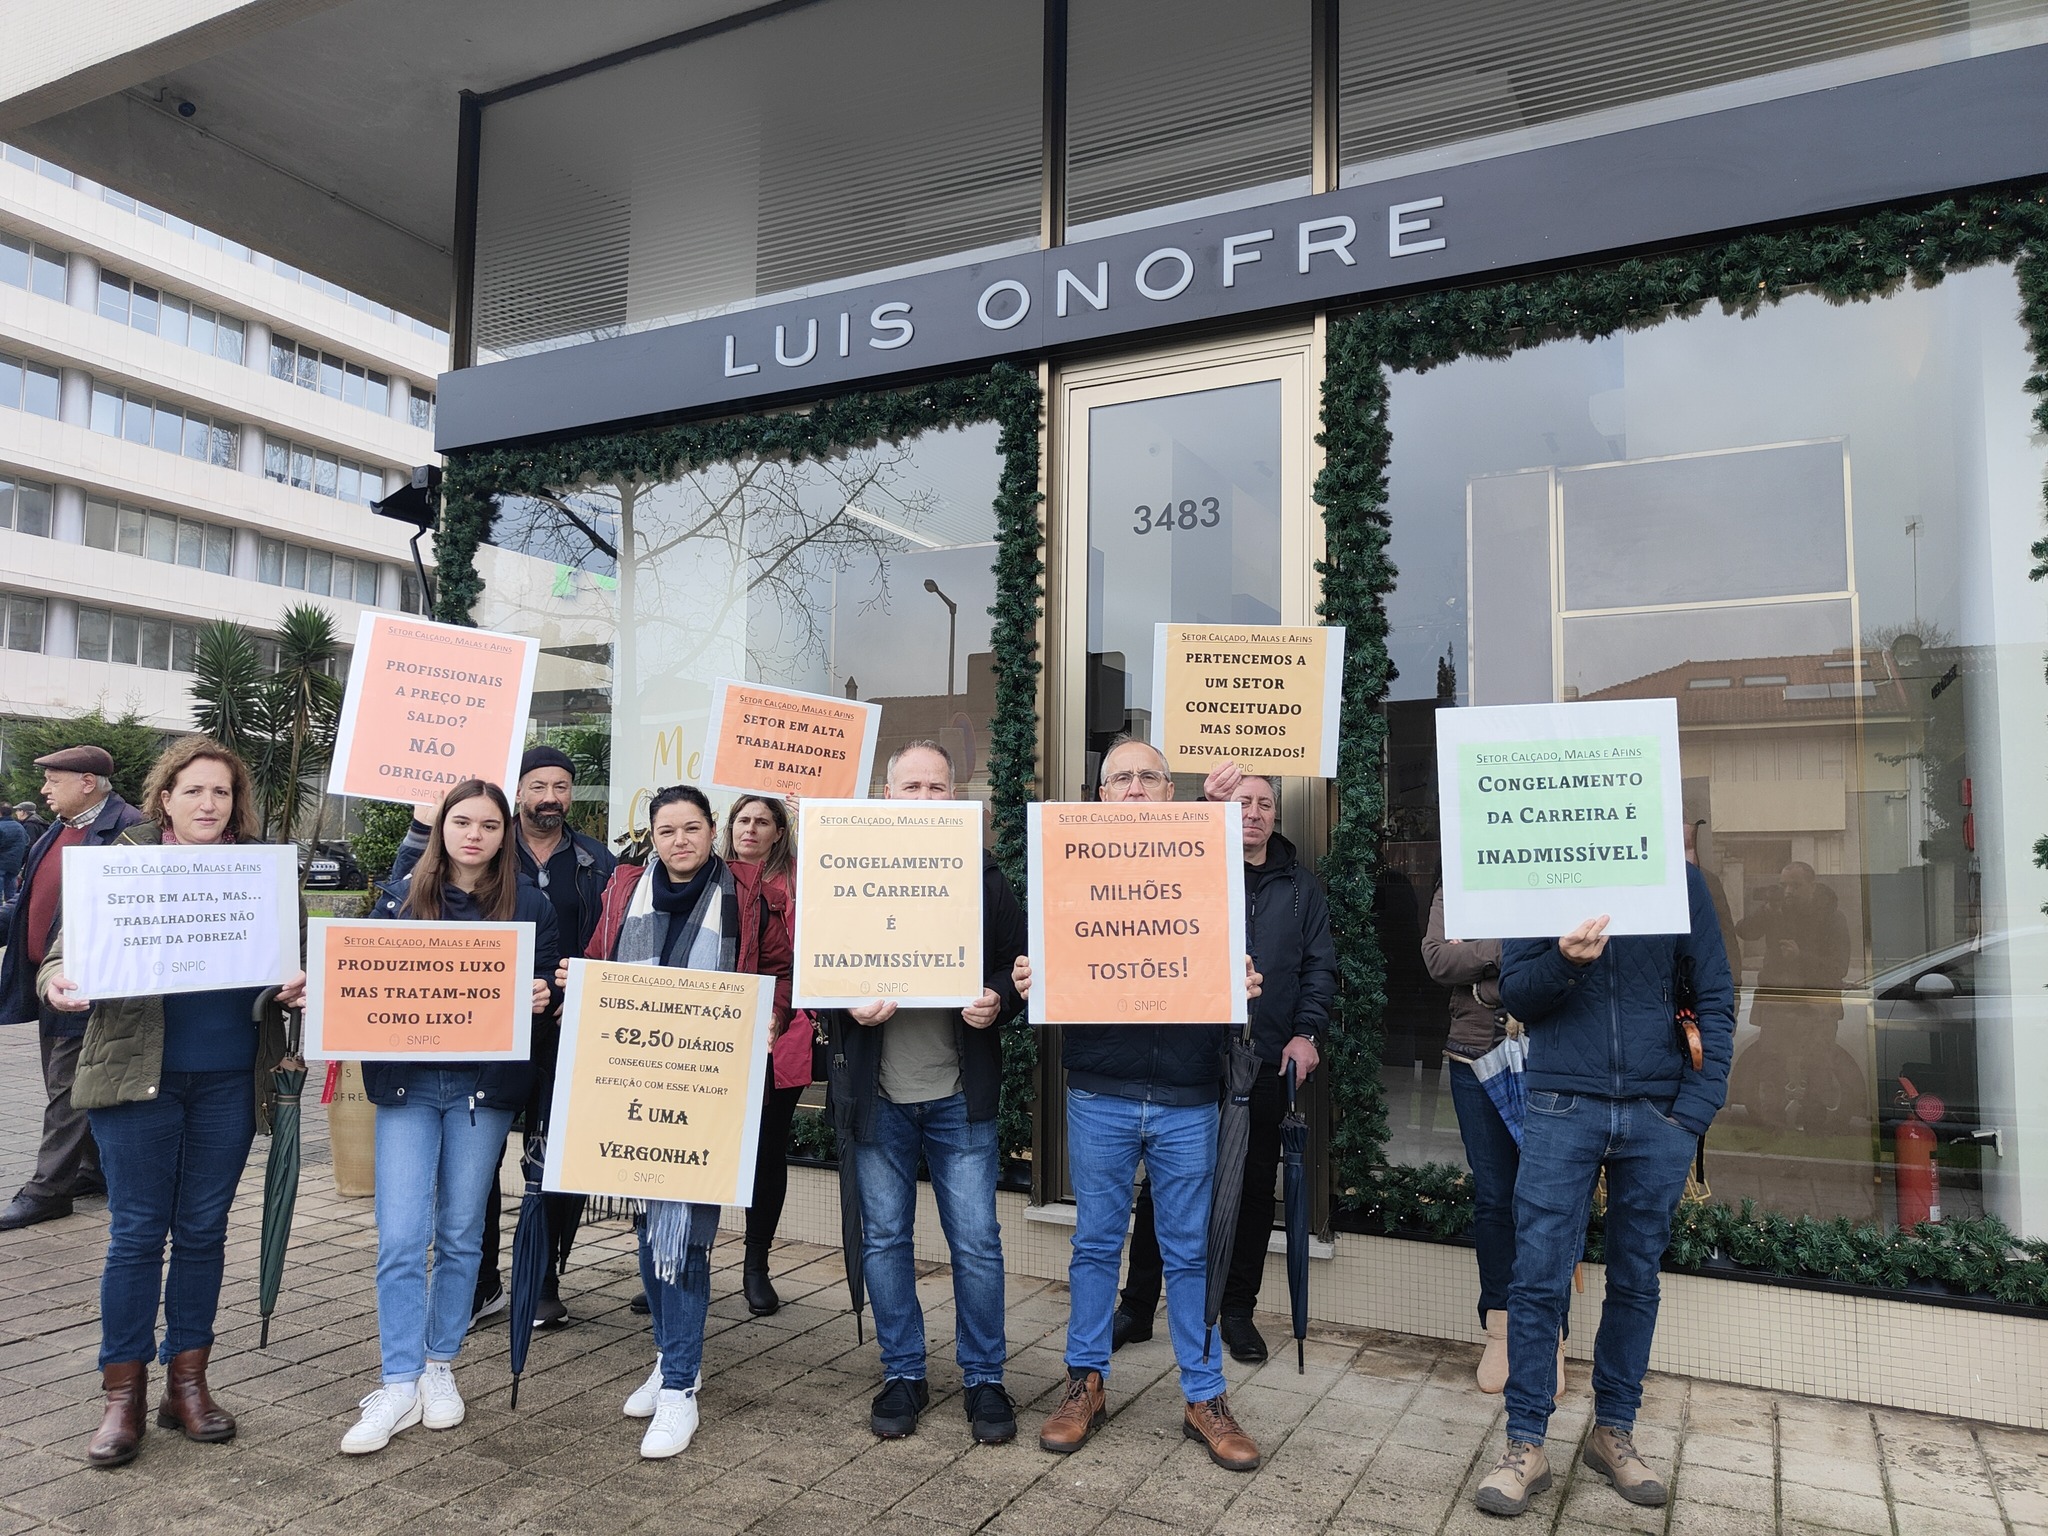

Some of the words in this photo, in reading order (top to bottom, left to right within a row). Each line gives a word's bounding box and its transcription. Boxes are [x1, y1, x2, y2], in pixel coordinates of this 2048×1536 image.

[724, 300, 915, 378] LUIS
[977, 196, 1447, 332] ONOFRE
[1133, 497, 1220, 535] 3483
[388, 626, 413, 637] SETOR
[415, 630, 453, 644] CALÇADO,
[455, 637, 483, 647] MALAS
[490, 643, 513, 653] AFINS
[1182, 633, 1207, 641] SETOR
[1209, 633, 1249, 643] CALÇADO,
[1251, 634, 1280, 643] MALAS
[1289, 635, 1312, 643] AFINS
[1186, 653, 1292, 665] PERTENCEMOS
[1296, 656, 1306, 665] A
[386, 660, 503, 687] PROFISSIONAIS
[1205, 678, 1227, 688] UM
[1233, 678, 1284, 690] SETOR
[395, 687, 405, 696] A
[411, 688, 461, 705] PREÇO
[466, 696, 486, 708] DE
[739, 695, 763, 704] SETOR
[764, 699, 799, 712] CALÇADO,
[802, 705, 827, 715] MALAS
[834, 710, 855, 719] AFINS
[1186, 701, 1302, 715] CONCEITUADO
[407, 710, 467, 728] SALDO?
[744, 714, 785, 729] SETOR
[790, 721, 809, 732] EM
[812, 725, 845, 738] ALTA
[1200, 724, 1230, 734] MAS
[1236, 725, 1286, 735] SOMOS
[409, 737, 455, 756] NÃO
[736, 735, 846, 760] TRABALHADORES
[1179, 745, 1305, 758] DESVALORIZADOS!
[1476, 753, 1508, 763] SETOR
[1511, 751, 1561, 763] CALÇADO,
[1564, 749, 1600, 760] MALAS
[1612, 748, 1642, 758] AFINS
[754, 758, 774, 770] EM
[778, 761, 822, 777] BAIXA!
[776, 779, 802, 790] SNPIC
[1478, 772, 1643, 793] CONGELAMENTO
[820, 816, 848, 825] SETOR
[851, 816, 894, 826] CALÇADO,
[897, 816, 928, 825] MALAS
[938, 816, 963, 825] AFINS
[1059, 813, 1088, 823] SETOR
[1090, 813, 1136, 823] CALÇADO,
[1139, 812, 1172, 821] MALAS
[1182, 812, 1209, 820] AFINS
[1487, 811, 1513, 824] DA
[1520, 806, 1619, 823] CARREIRA
[1626, 803, 1636, 820] É
[1065, 841, 1205, 859] PRODUZIMOS
[1478, 836, 1648, 865] INADMISSÍVEL!
[103, 864, 138, 874] SETOR
[141, 864, 190, 875] CALÇADO,
[193, 864, 226, 873] MALAS
[235, 863, 261, 872] AFINS
[820, 854, 964, 869] CONGELAMENTO
[1546, 872, 1582, 884] SNPIC
[834, 885, 857, 897] DA
[863, 882, 949, 897] CARREIRA
[1090, 880, 1182, 901] MILHÕES
[108, 893, 154, 904] SETOR
[160, 894, 178, 902] EM
[182, 892, 218, 902] ALTA,
[223, 892, 261, 900] MAS...
[114, 912, 226, 926] TRABALHADORES
[230, 911, 255, 921] NÃO
[886, 915, 896, 930] É
[1075, 919, 1200, 937] GANHAMOS
[124, 935, 161, 946] SAEM
[166, 934, 183, 944] DA
[188, 930, 247, 943] POBREZA!
[344, 936, 375, 945] SETOR
[378, 937, 426, 948] CALÇADO,
[429, 938, 463, 947] MALAS
[473, 938, 501, 947] AFINS
[814, 946, 965, 968] INADMISSÍVEL!
[172, 960, 206, 972] SNPIC
[338, 959, 454, 972] PRODUZIMOS
[460, 961, 505, 972] LUXO
[1088, 956, 1188, 980] TOSTÕES!
[602, 971, 629, 983] SETOR
[632, 974, 675, 987] CALÇADO,
[678, 978, 710, 989] MALAS
[719, 982, 745, 992] AFINS
[877, 983, 909, 993] SNPIC
[341, 986, 378, 998] MAS
[384, 987, 501, 999] TRATAM-NOS
[1134, 1000, 1167, 1011] SNPIC
[367, 1012, 419, 1024] COMO
[426, 1011, 473, 1024] LIXO!
[407, 1035, 440, 1045] SNPIC
[615, 1027, 674, 1048] €2,50
[678, 1037, 734, 1053] DIÁRIOS
[609, 1057, 663, 1069] CONSEGUES
[665, 1062, 696, 1072] COMER
[700, 1064, 719, 1073] UMA
[595, 1076, 642, 1088] REFEIÇÃO
[644, 1080, 664, 1090] COM
[666, 1083, 689, 1092] ESSE
[692, 1084, 728, 1095] VALOR?
[628, 1099, 643, 1121] É
[648, 1107, 688, 1125] UMA
[599, 1141, 710, 1166] VERGONHA!
[634, 1172, 665, 1184] SNPIC
